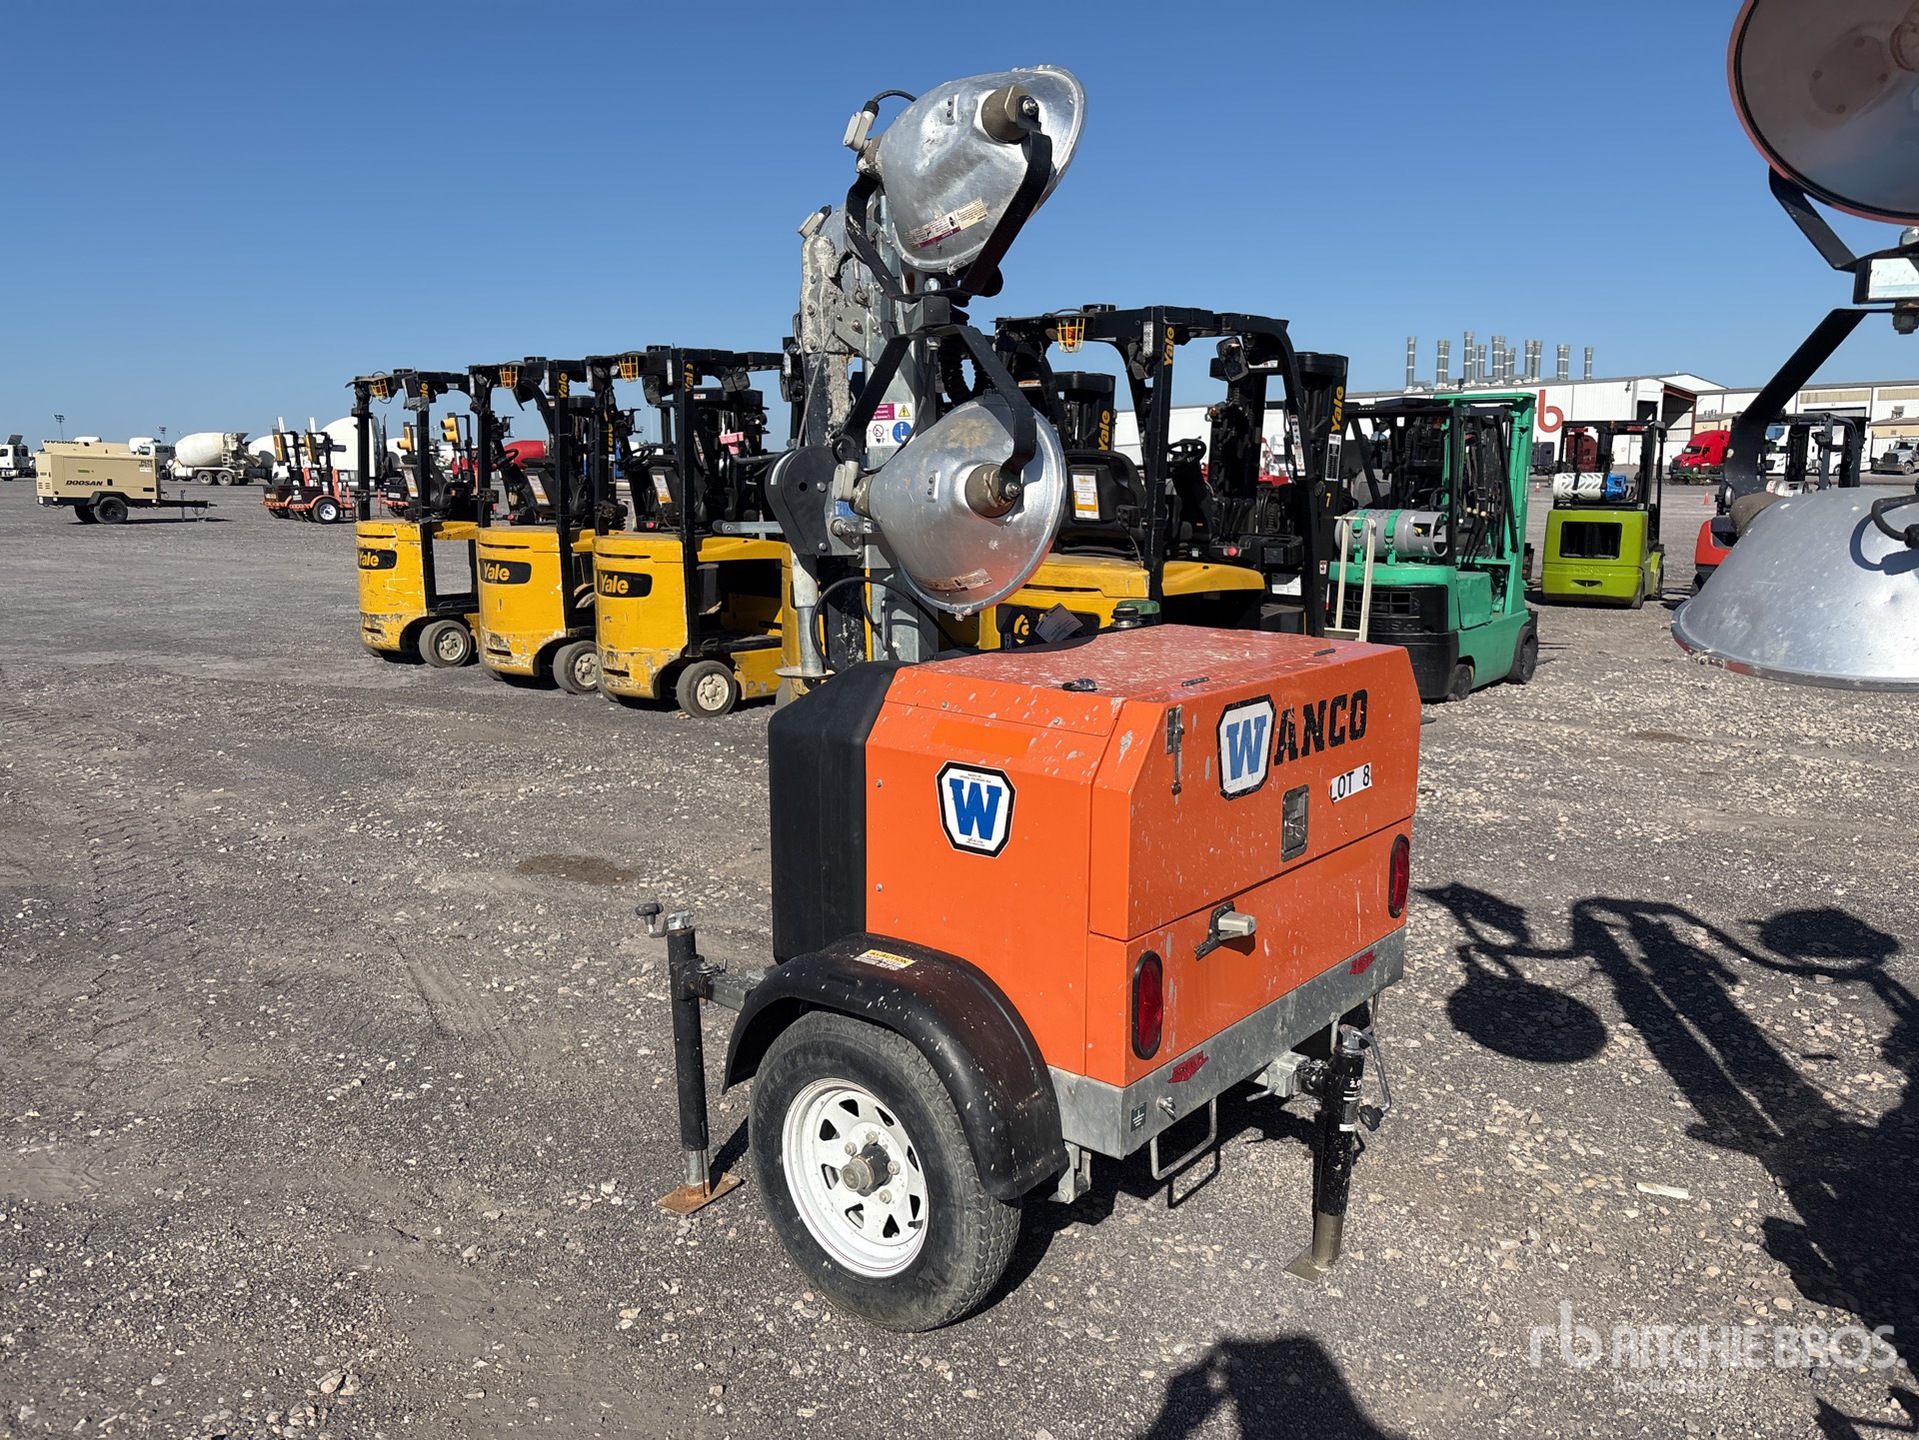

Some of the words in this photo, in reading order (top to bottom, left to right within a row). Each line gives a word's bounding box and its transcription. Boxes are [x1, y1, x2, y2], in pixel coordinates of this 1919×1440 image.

[1163, 326, 1175, 366] Yale
[420, 382, 429, 398] ale
[558, 372, 568, 398] Yale
[1331, 385, 1344, 433] Yale
[1098, 410, 1111, 451] Yale
[484, 562, 510, 581] Yale
[600, 575, 628, 594] Yale
[1330, 770, 1355, 801] LOT
[1361, 765, 1371, 787] 8
[948, 777, 1002, 841] W
